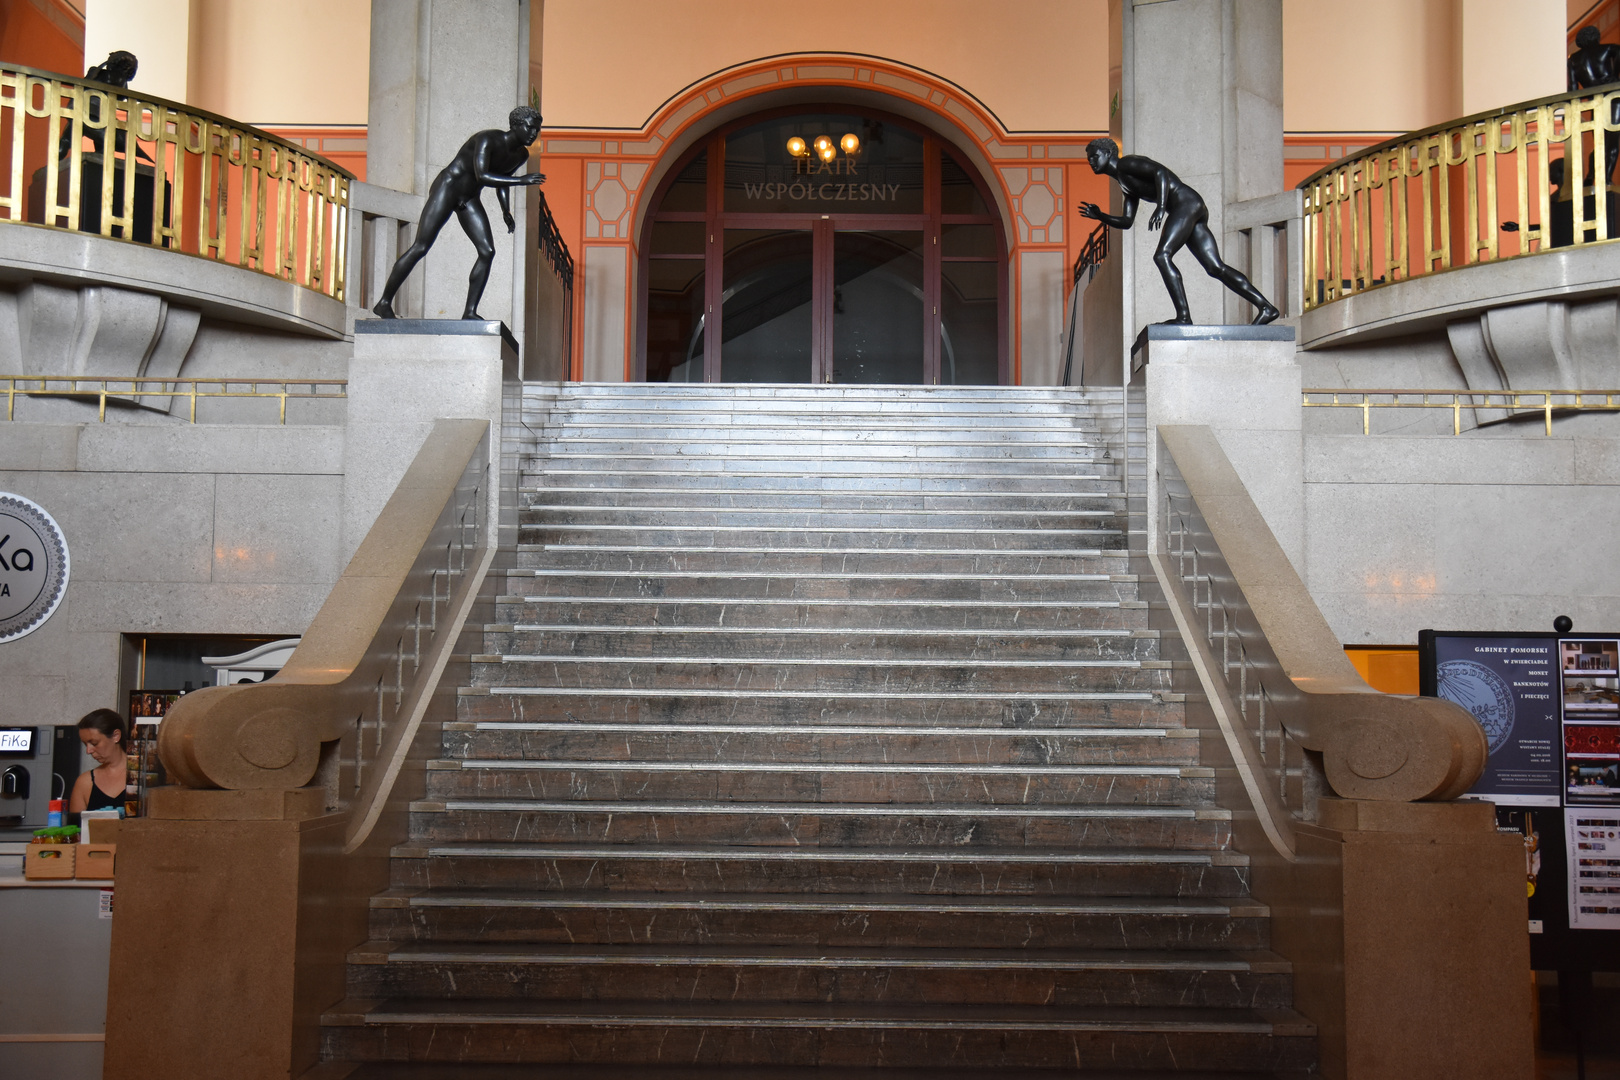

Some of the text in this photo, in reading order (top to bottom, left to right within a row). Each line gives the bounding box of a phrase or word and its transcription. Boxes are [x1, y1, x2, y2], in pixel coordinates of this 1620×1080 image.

[792, 157, 858, 175] TEATR
[744, 178, 901, 201] WSPÓŁCZESNY
[1, 734, 28, 747] FiKa
